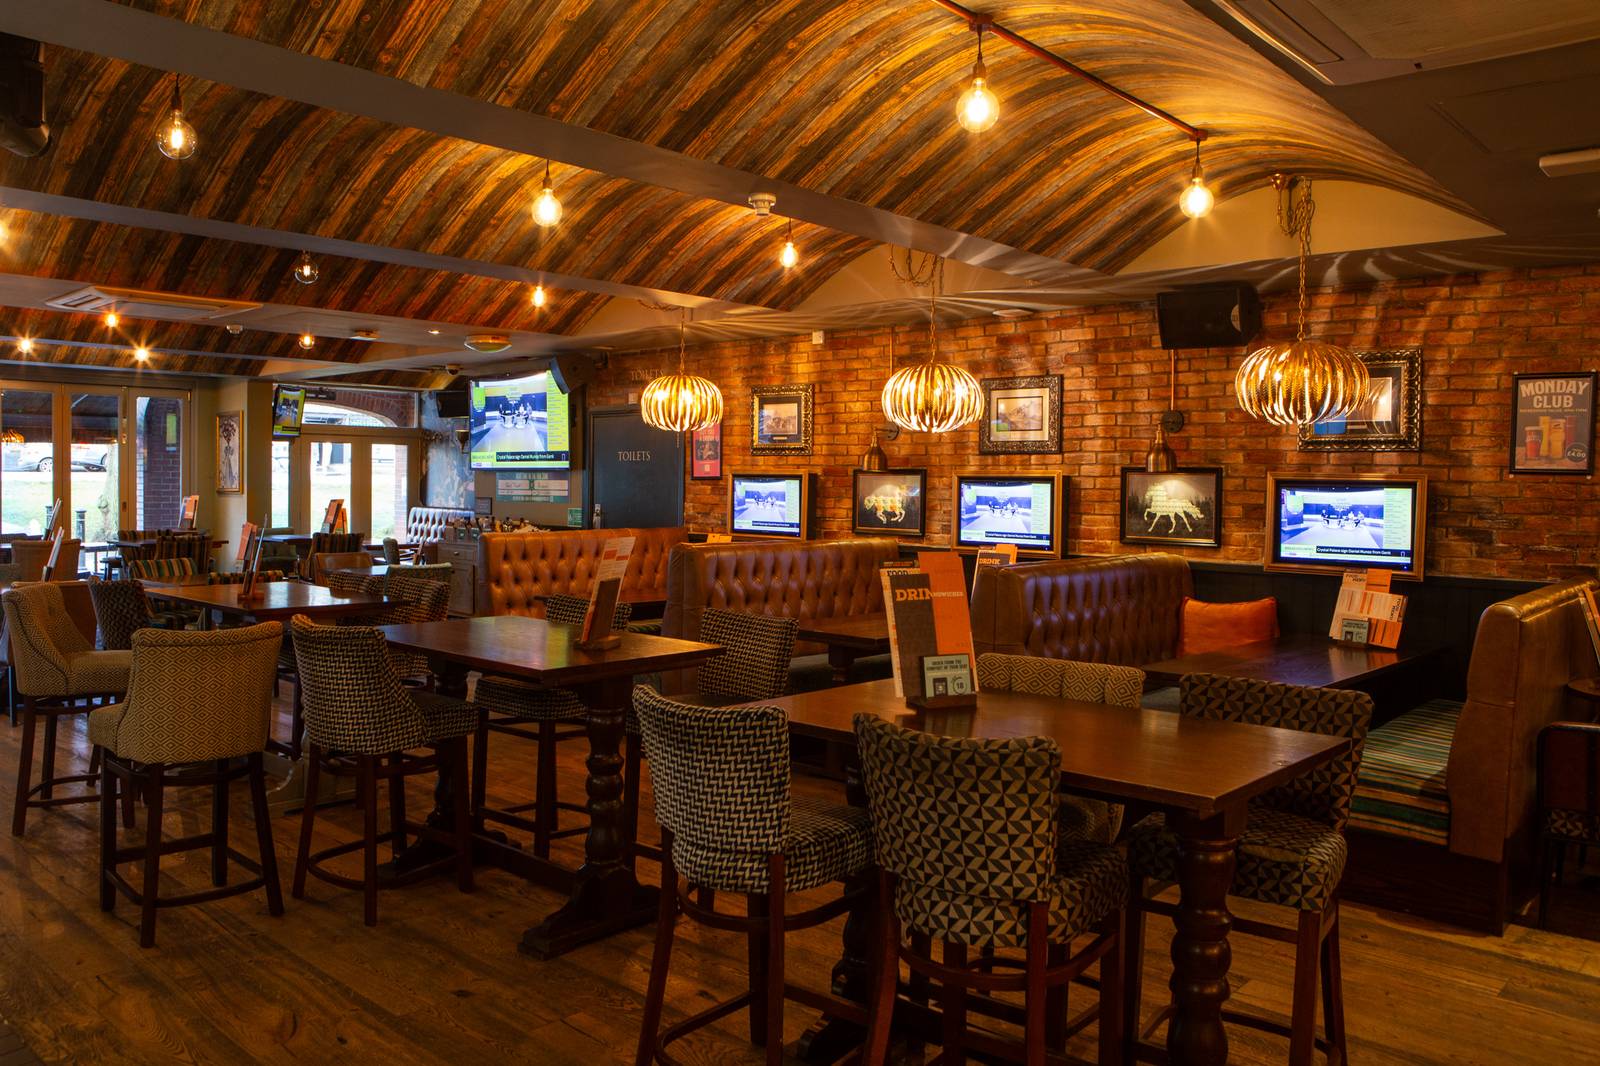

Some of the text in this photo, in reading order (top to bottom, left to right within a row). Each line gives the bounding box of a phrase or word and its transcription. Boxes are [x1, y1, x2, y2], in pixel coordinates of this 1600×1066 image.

[631, 369, 664, 381] TOILETS
[1520, 379, 1590, 397] MONDAY
[1533, 395, 1573, 408] CLUB
[618, 450, 651, 462] TOILETS
[896, 588, 932, 601] DRIN
